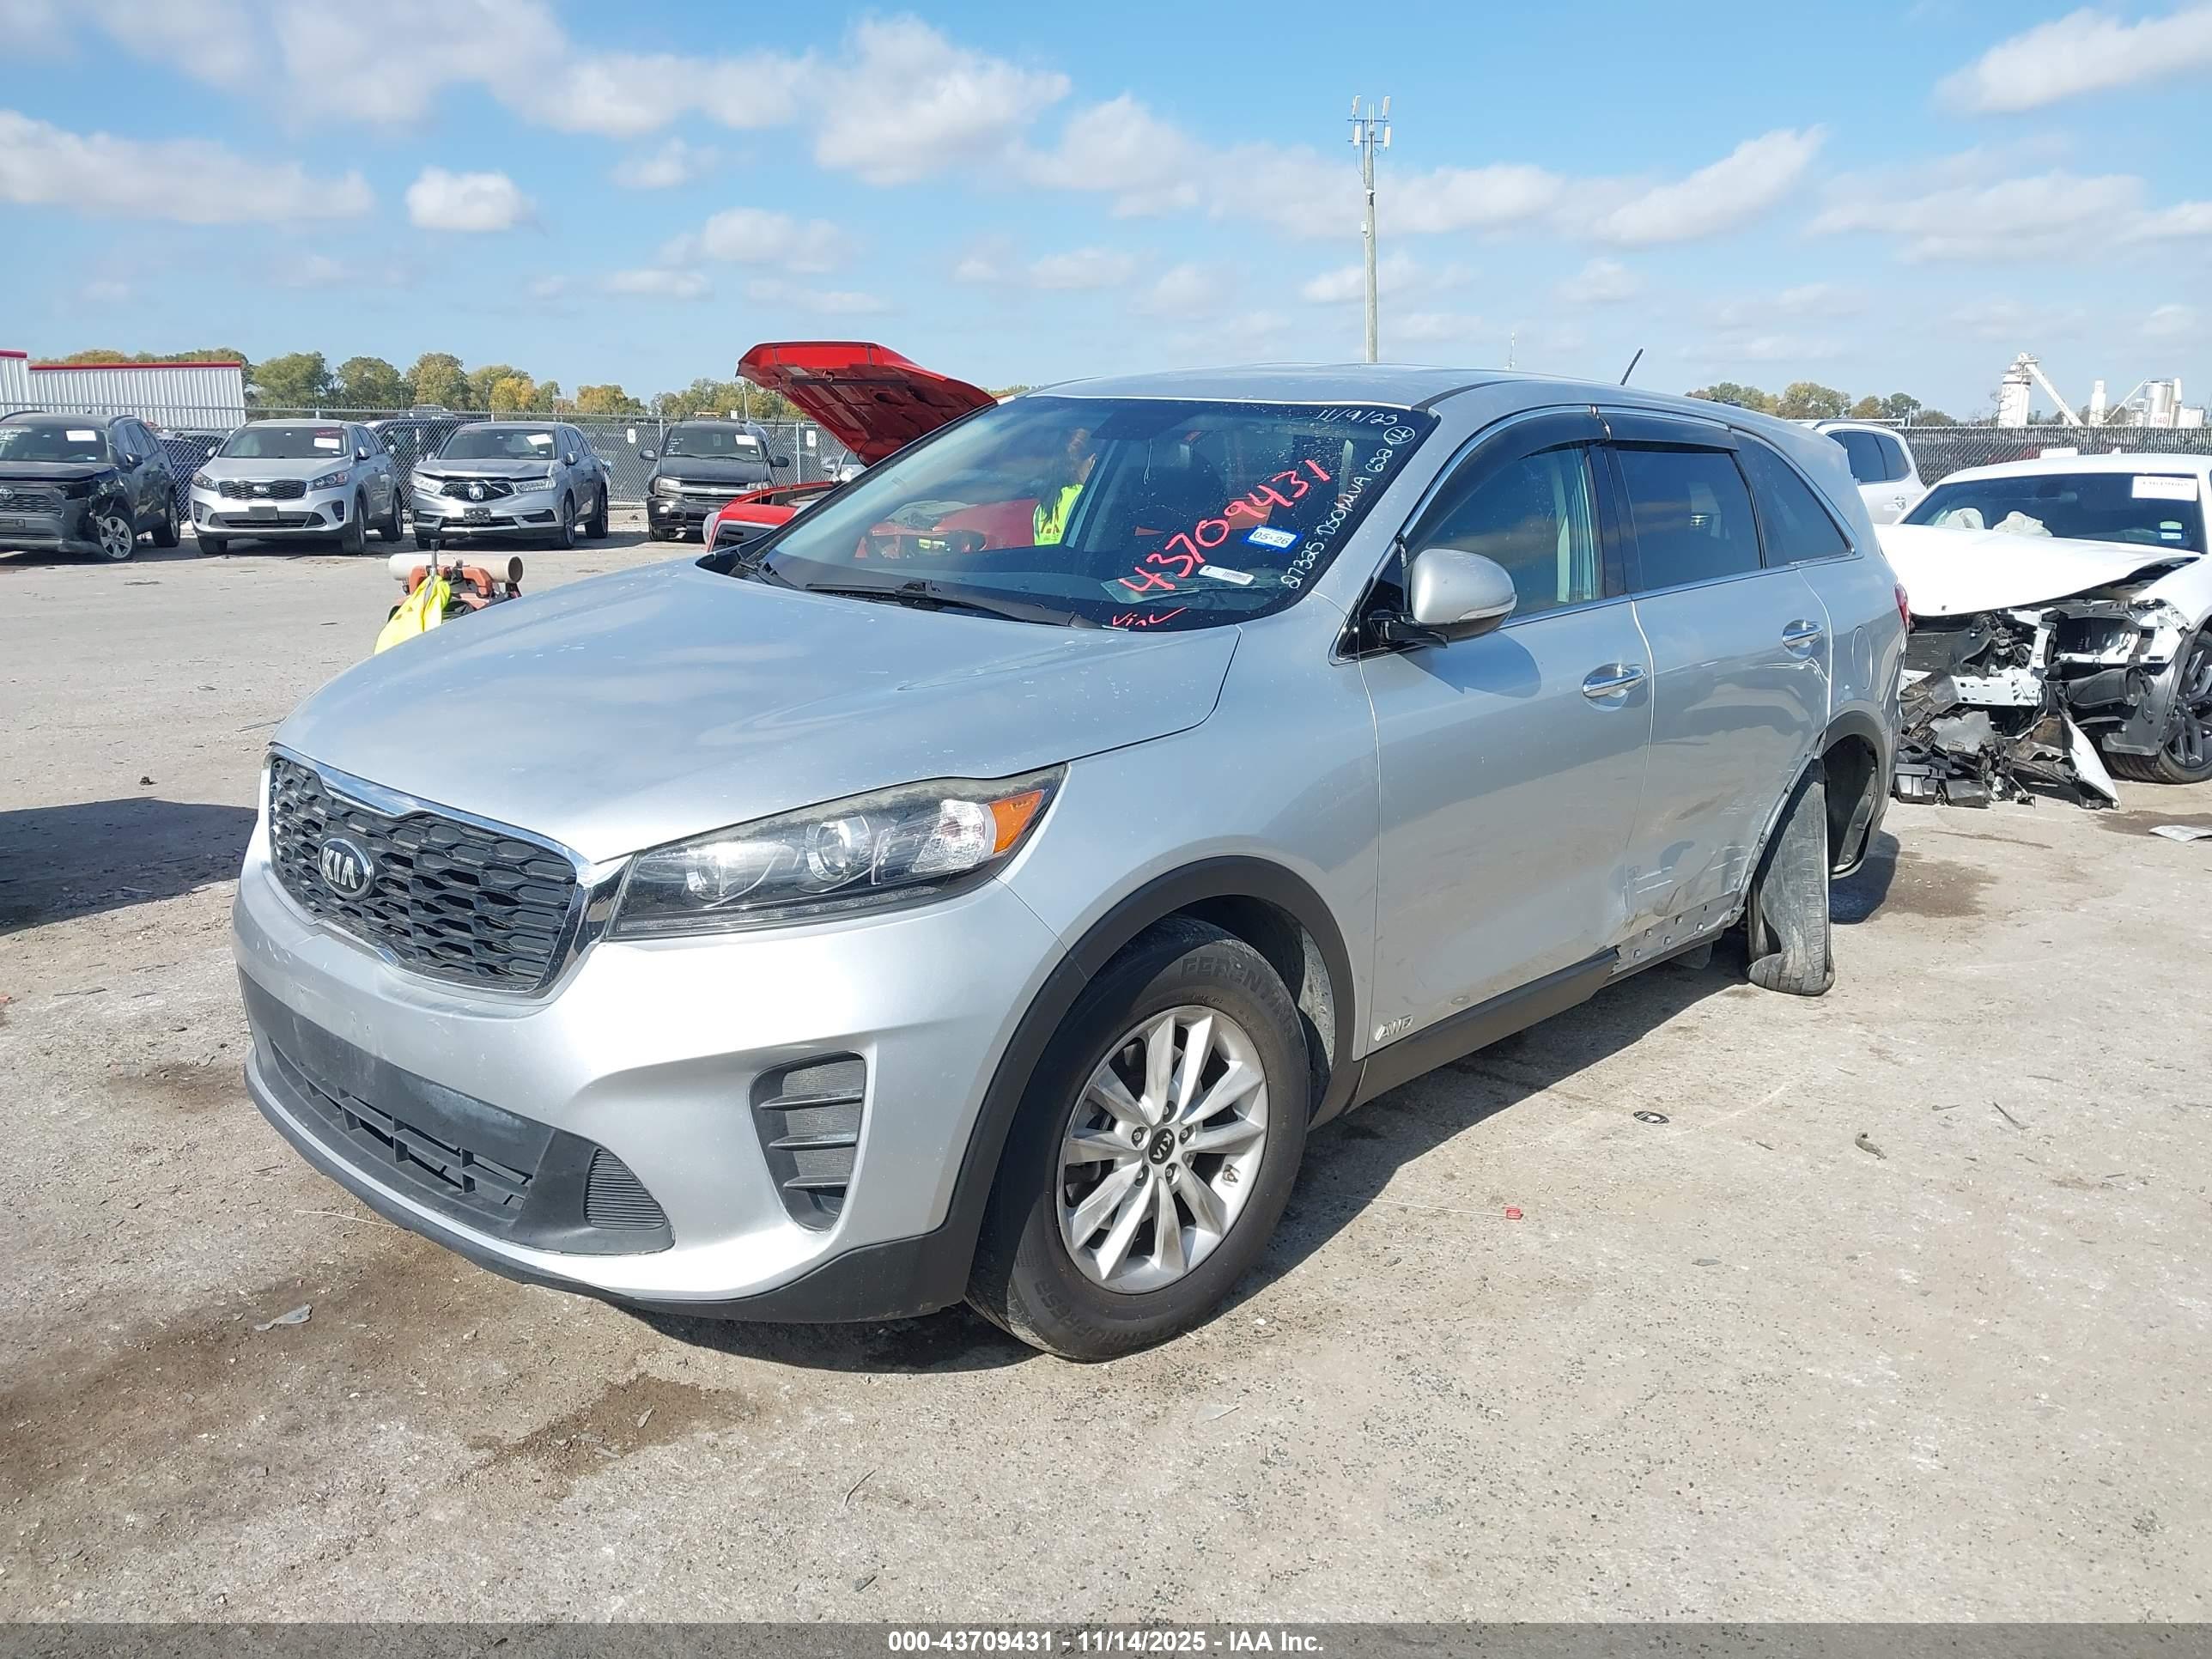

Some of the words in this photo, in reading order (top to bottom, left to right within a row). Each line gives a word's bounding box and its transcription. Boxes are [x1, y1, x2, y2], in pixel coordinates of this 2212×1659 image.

[1118, 459, 1330, 591] 43709431
[1280, 540, 1324, 590] 27325
[321, 847, 357, 890] KIA
[1374, 1014, 1414, 1042] AWD
[1152, 1132, 1173, 1159] KIA
